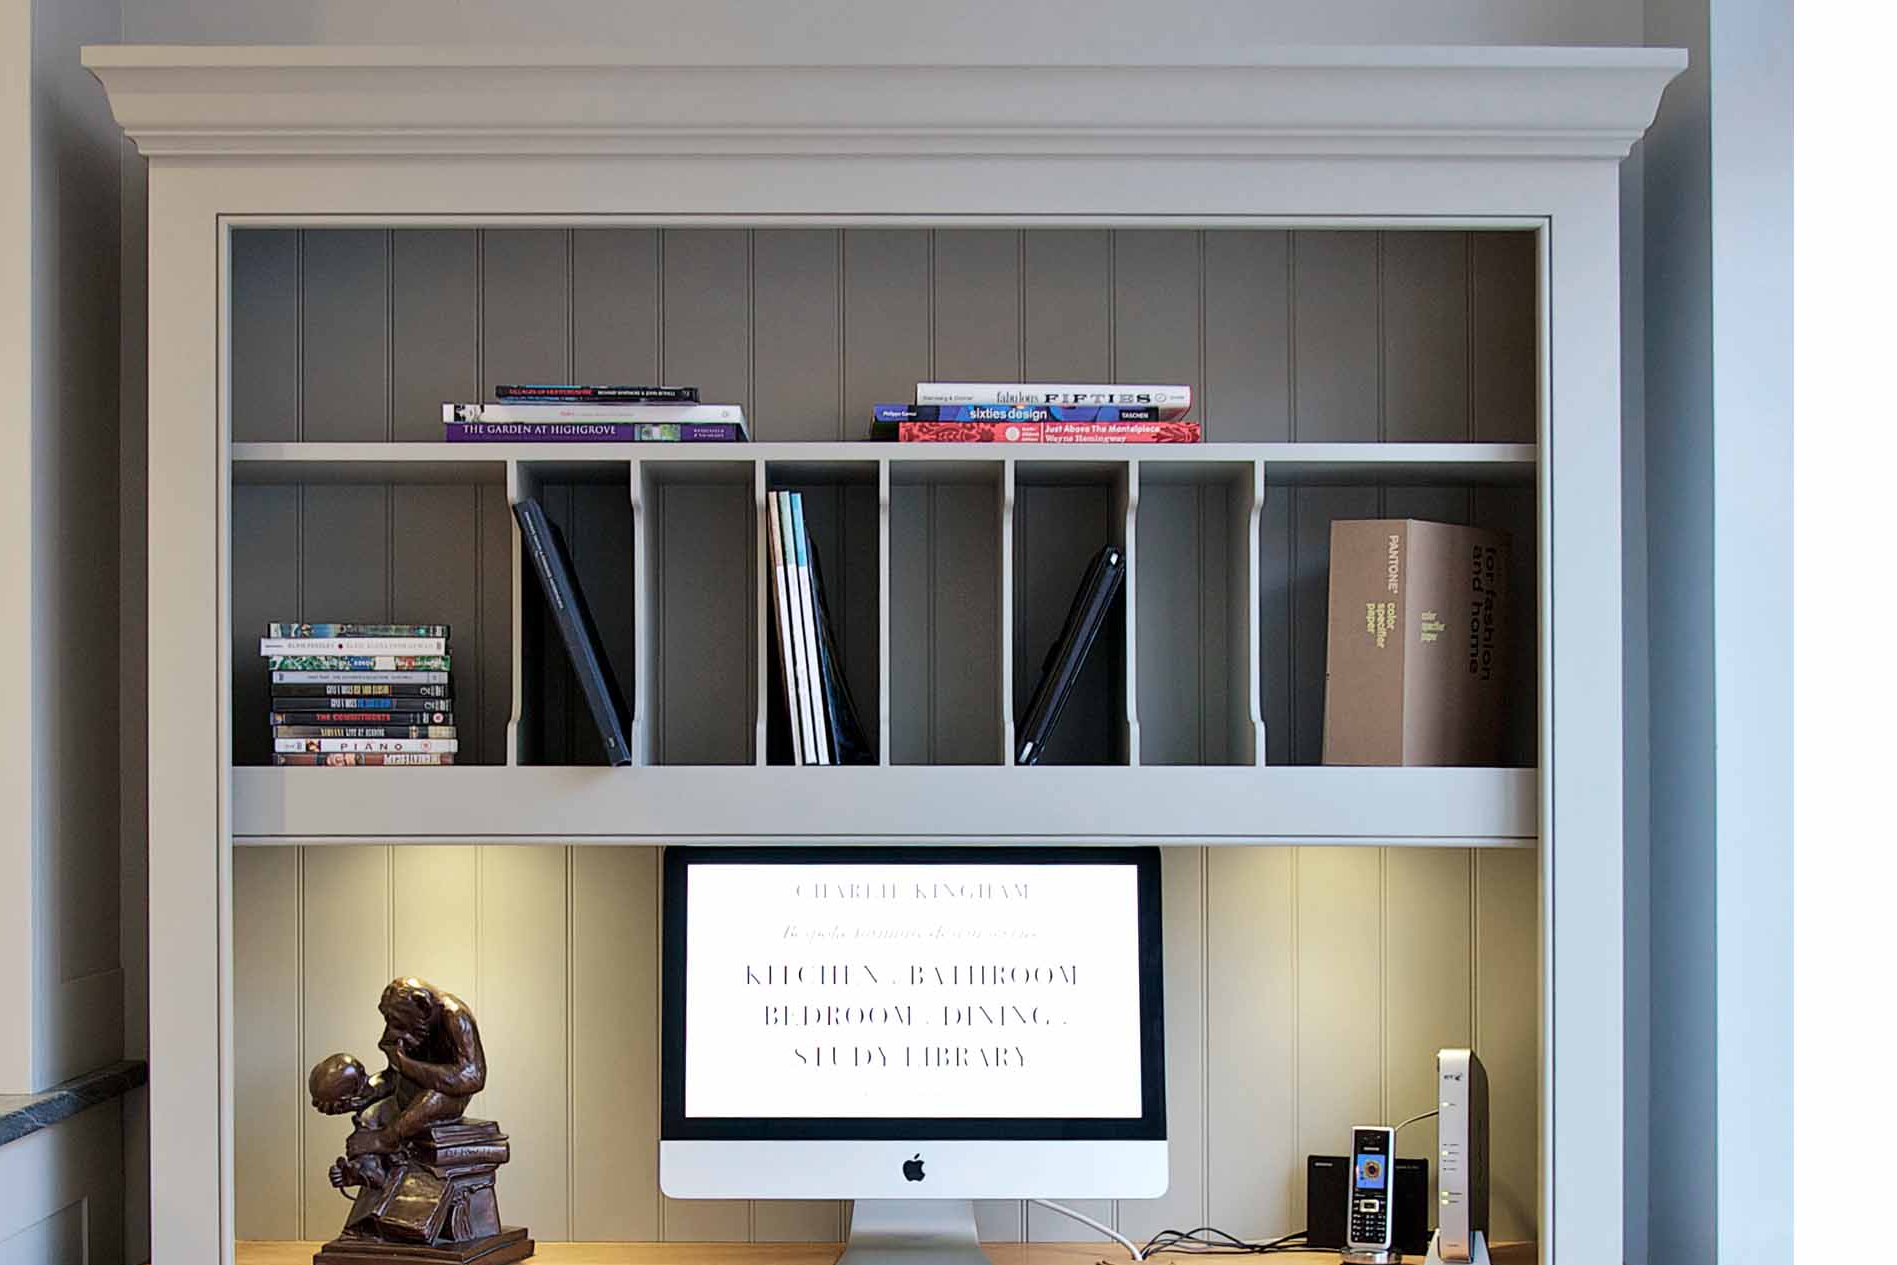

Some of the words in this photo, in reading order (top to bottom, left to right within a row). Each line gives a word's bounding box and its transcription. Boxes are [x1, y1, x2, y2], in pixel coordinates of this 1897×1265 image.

[1045, 394, 1151, 403] FIFTIES
[970, 408, 1006, 419] sixties
[1008, 408, 1048, 422] design
[463, 425, 484, 434] THE
[487, 425, 532, 434] GARDEN
[535, 425, 547, 434] AT
[551, 425, 616, 434] HIGHGROVE
[1045, 425, 1063, 433] Just
[1064, 425, 1093, 433] Above
[1095, 425, 1108, 433] The
[1472, 545, 1484, 592] and
[1485, 547, 1496, 583] for
[1469, 602, 1483, 674] home
[1481, 590, 1496, 680] fashion
[340, 743, 403, 751] PIANO
[916, 883, 1028, 899] KINGHAM
[747, 965, 880, 985] KITCHEN
[911, 965, 1077, 985] BATHROOM
[765, 1005, 911, 1026] BEDROOM
[944, 1005, 1050, 1026] DINING
[794, 1046, 888, 1067] STUDY
[906, 1046, 1025, 1067] LIBRARY
